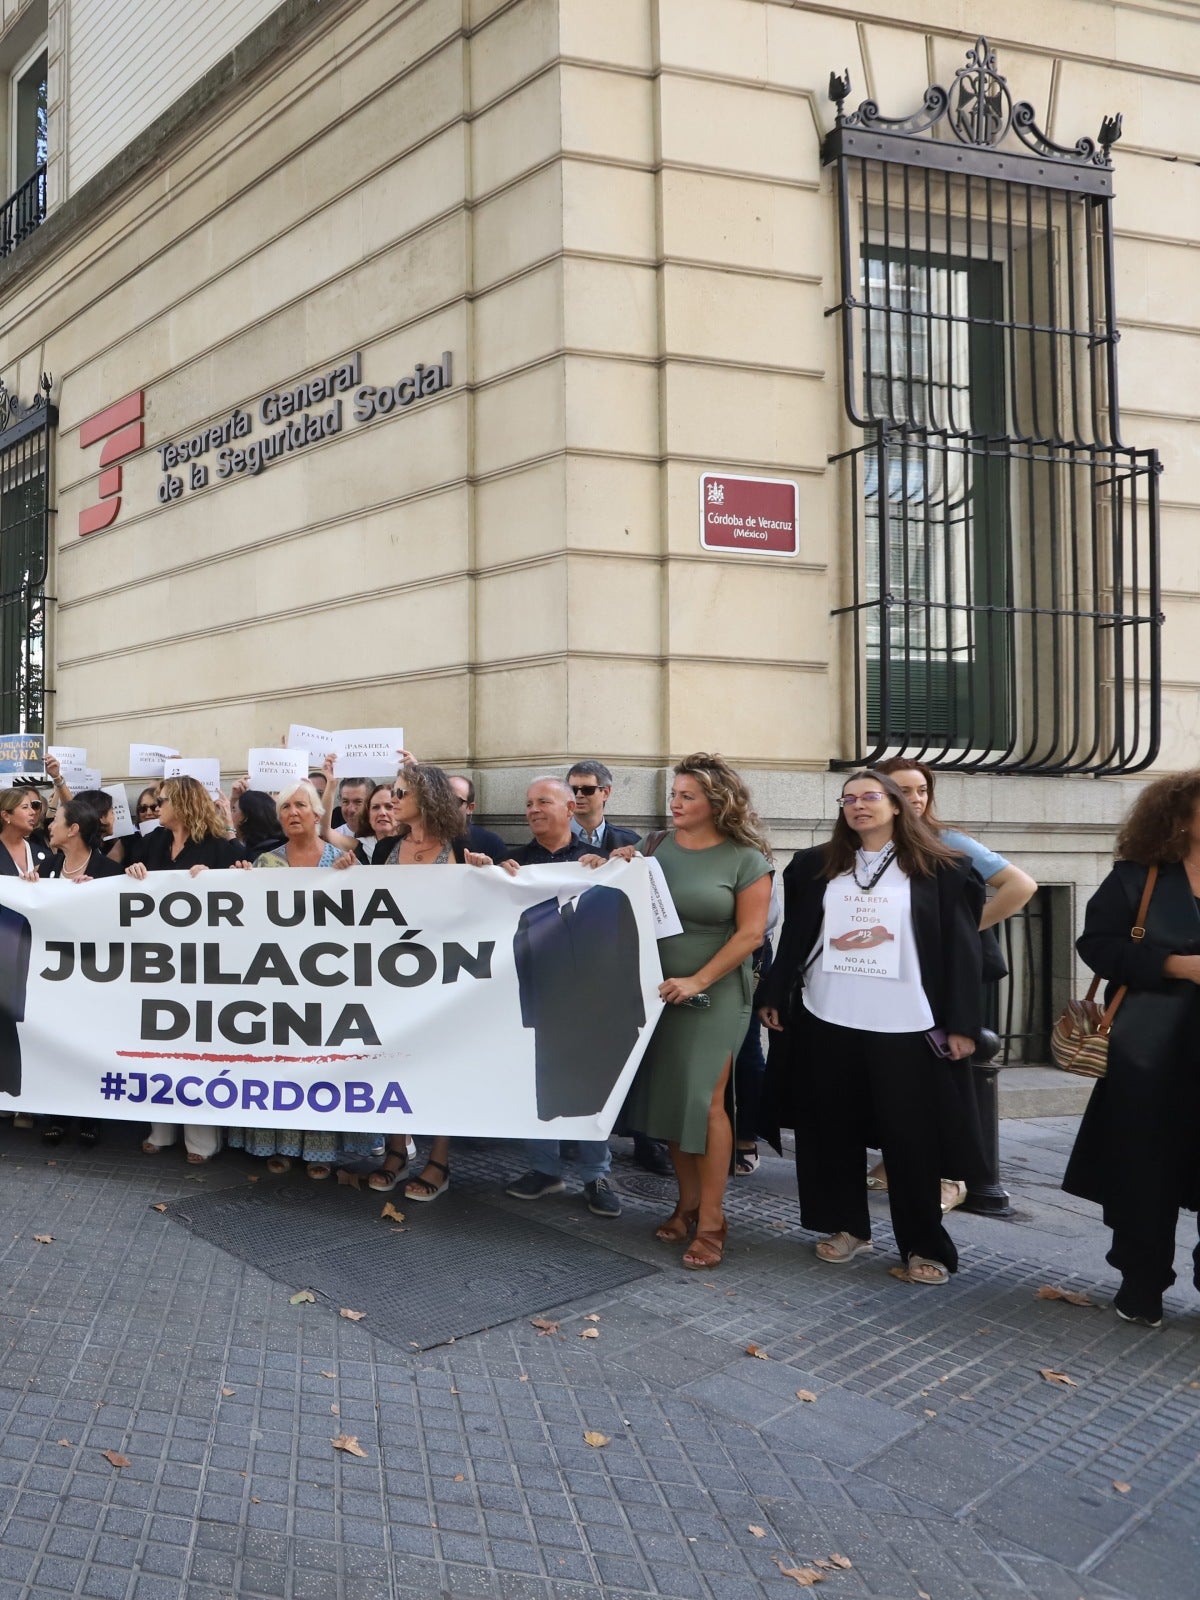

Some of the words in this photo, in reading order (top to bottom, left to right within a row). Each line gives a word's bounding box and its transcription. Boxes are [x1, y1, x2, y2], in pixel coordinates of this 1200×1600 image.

[157, 409, 252, 472] Tesorería
[258, 350, 362, 426] General
[157, 473, 184, 503] de
[189, 463, 209, 491] la
[215, 399, 343, 476] Seguridad
[352, 350, 453, 423] Social
[707, 511, 743, 527] Córdoba
[745, 516, 756, 528] de
[758, 516, 793, 531] Veracruz
[733, 528, 769, 541] (México)
[119, 890, 245, 928] POR
[266, 887, 409, 928] UNA
[854, 895, 865, 903] AL
[867, 896, 889, 904] RETA
[858, 930, 872, 938] #J2
[39, 929, 496, 988] JUBILACIÓN
[833, 964, 888, 975] MUTUALIDAD
[845, 956, 858, 964] NO
[139, 999, 382, 1047] DIGNA
[100, 1068, 413, 1116] #J2CÓRDOBA
